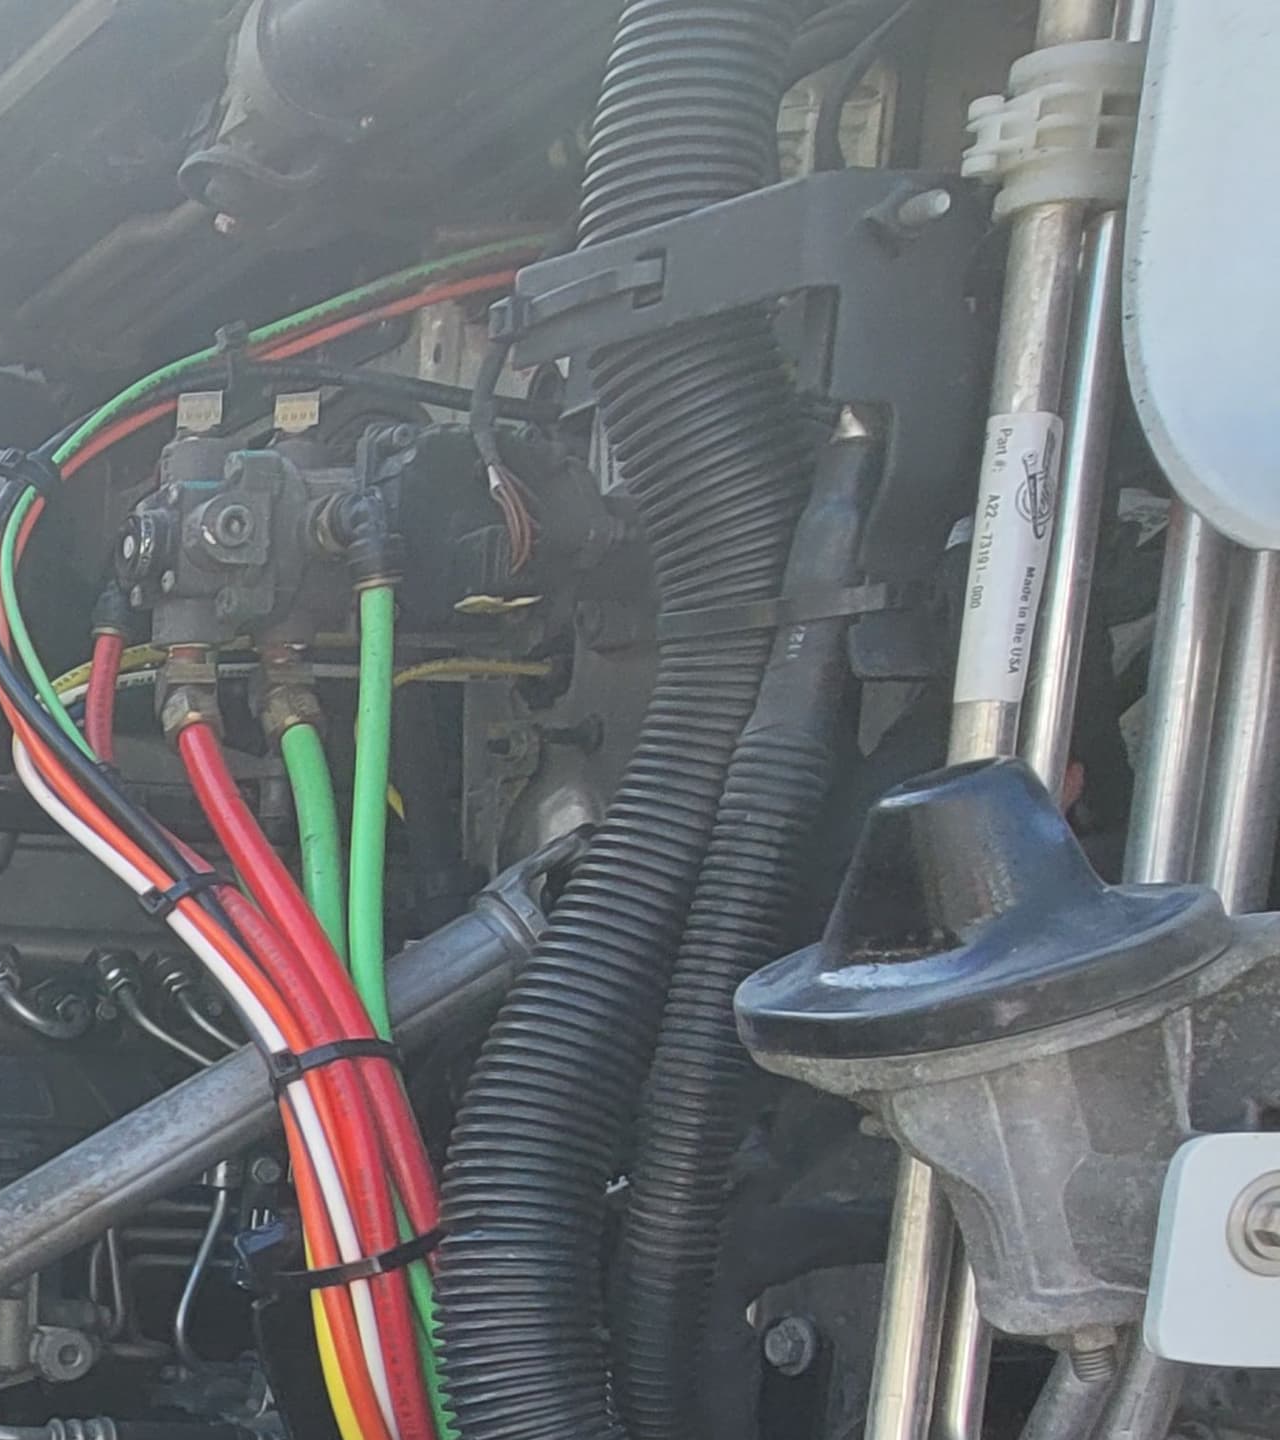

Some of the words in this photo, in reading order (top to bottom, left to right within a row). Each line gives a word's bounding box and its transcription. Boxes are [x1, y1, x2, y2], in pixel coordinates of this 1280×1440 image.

[996, 427, 1013, 455] Part
[1020, 565, 1036, 603] Made
[1014, 622, 1026, 643] the
[1007, 645, 1024, 674] USA
